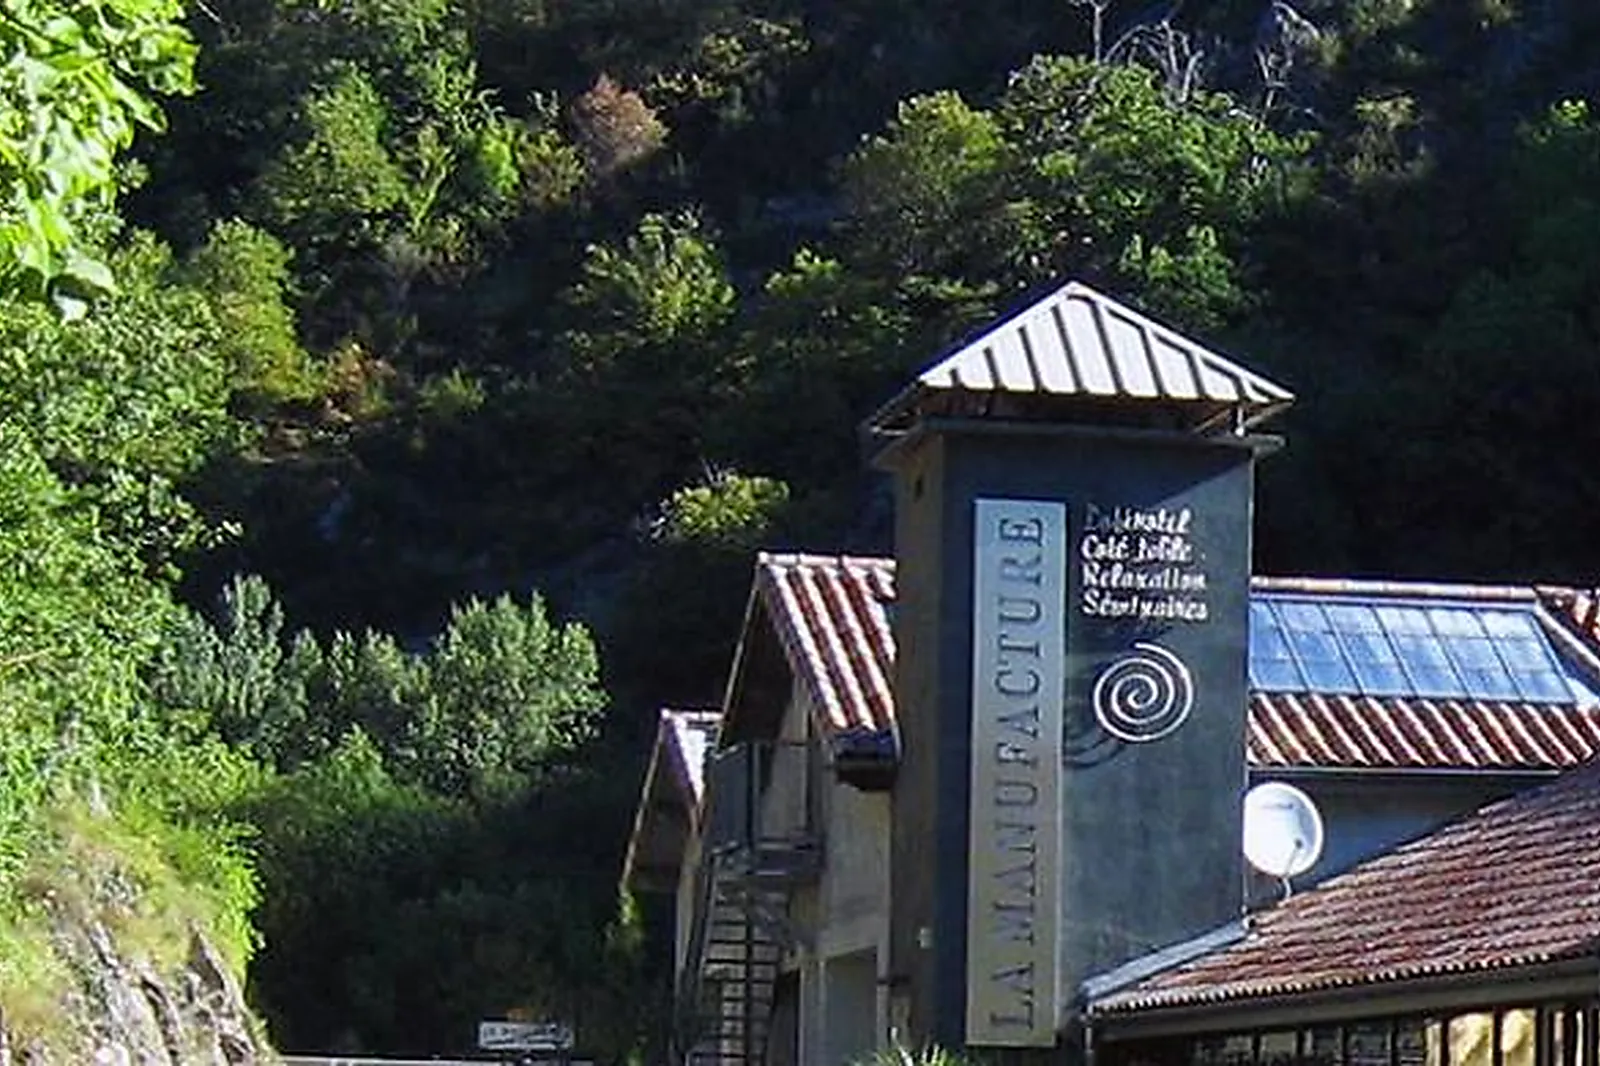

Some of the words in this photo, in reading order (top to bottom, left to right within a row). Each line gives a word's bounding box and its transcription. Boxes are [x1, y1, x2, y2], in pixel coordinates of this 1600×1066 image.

[1082, 561, 1208, 591] Relaxation
[992, 517, 1044, 947] MANUFACTURE
[990, 961, 1035, 1032] LA
